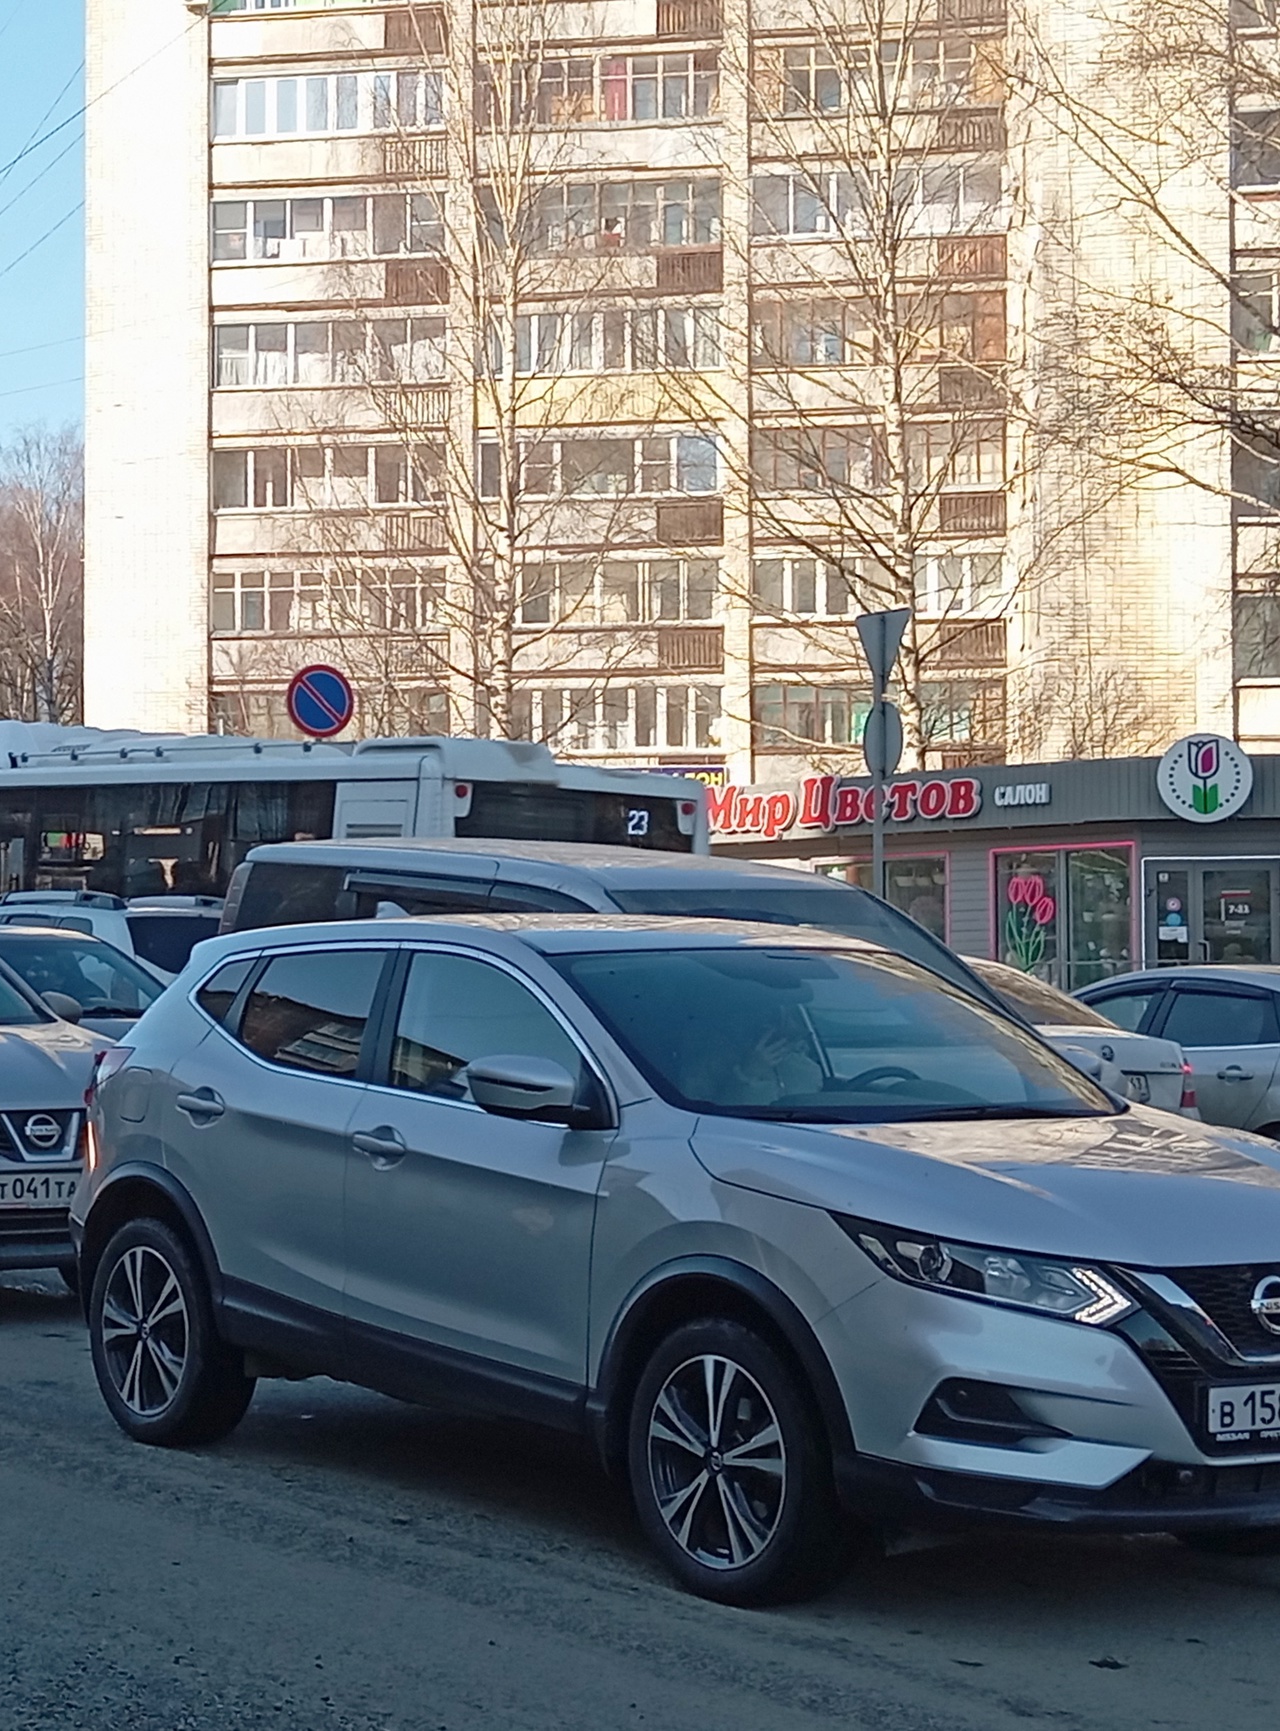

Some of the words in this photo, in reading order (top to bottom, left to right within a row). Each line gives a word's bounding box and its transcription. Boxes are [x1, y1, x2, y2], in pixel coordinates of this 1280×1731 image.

[705, 785, 792, 838] Мир
[799, 776, 978, 830] Цветов
[994, 783, 1050, 806] САЛОН
[627, 810, 649, 835] 23
